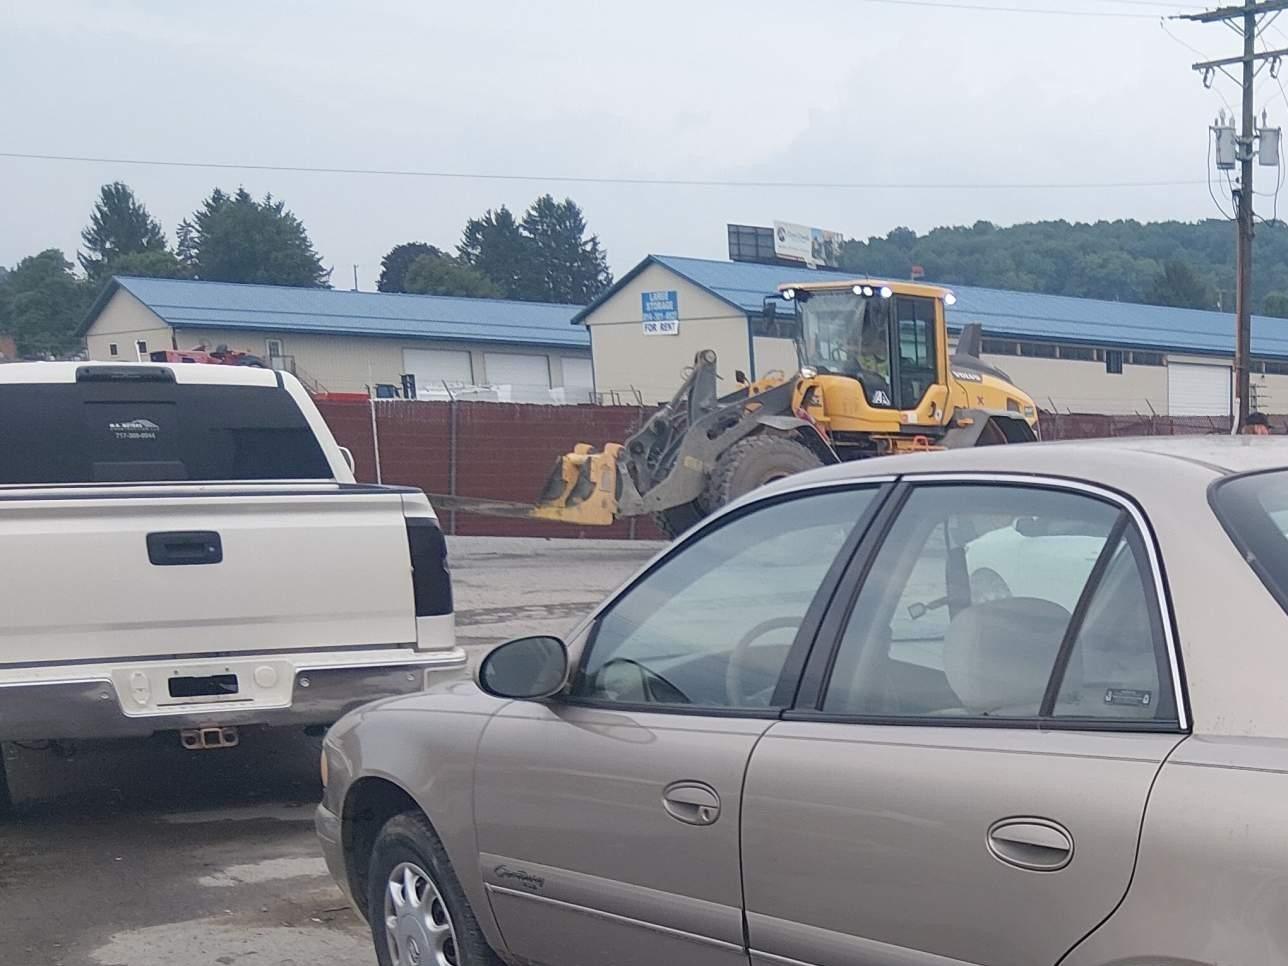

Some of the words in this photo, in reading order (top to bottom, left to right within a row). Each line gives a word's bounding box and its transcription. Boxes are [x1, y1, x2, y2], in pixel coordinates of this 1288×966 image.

[644, 323, 657, 332] FOR
[660, 321, 676, 331] RENT
[951, 370, 981, 381] VOLVO
